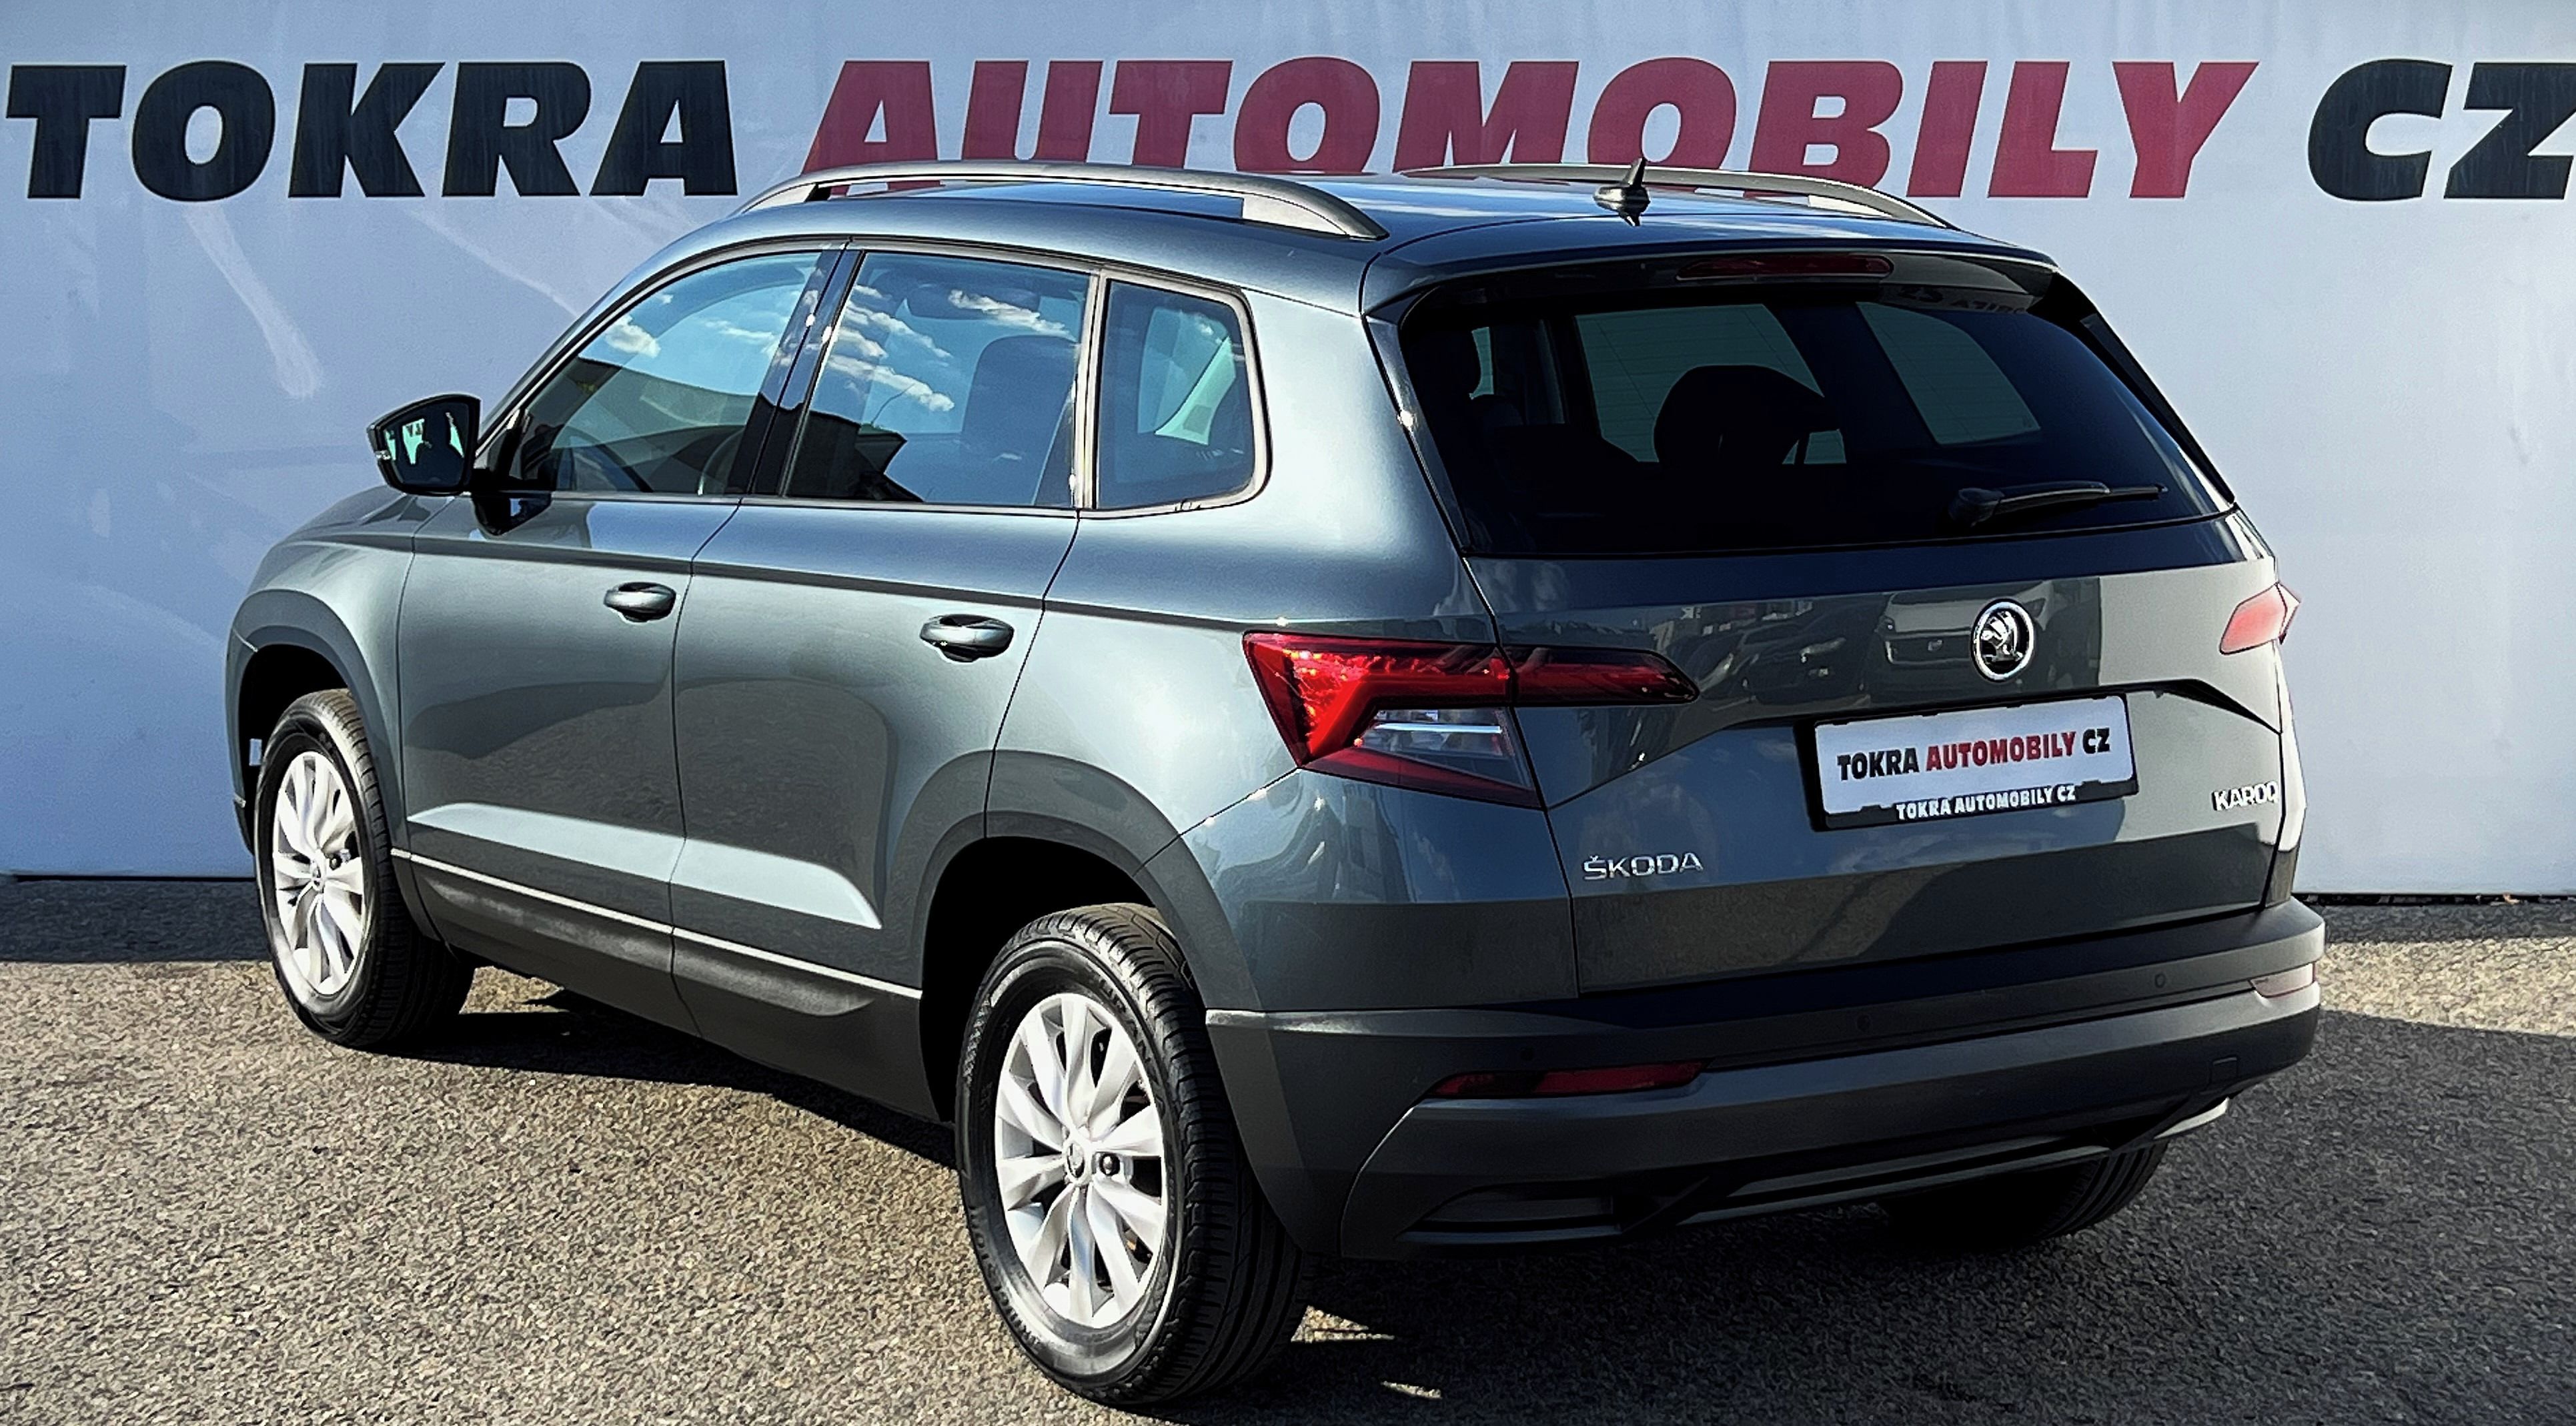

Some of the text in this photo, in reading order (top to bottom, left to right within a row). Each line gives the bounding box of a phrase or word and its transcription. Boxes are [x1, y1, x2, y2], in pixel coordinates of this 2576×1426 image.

[5, 57, 2576, 203] TOKRA AUTOMOBILY CZ
[1836, 727, 2111, 782] TOKRA AUTOMOBILY CZ
[1896, 785, 2076, 820] TOKRA AUTOMOBILY CZ
[2211, 780, 2279, 811] KAROQ
[1583, 852, 1704, 881] ŠKODA
